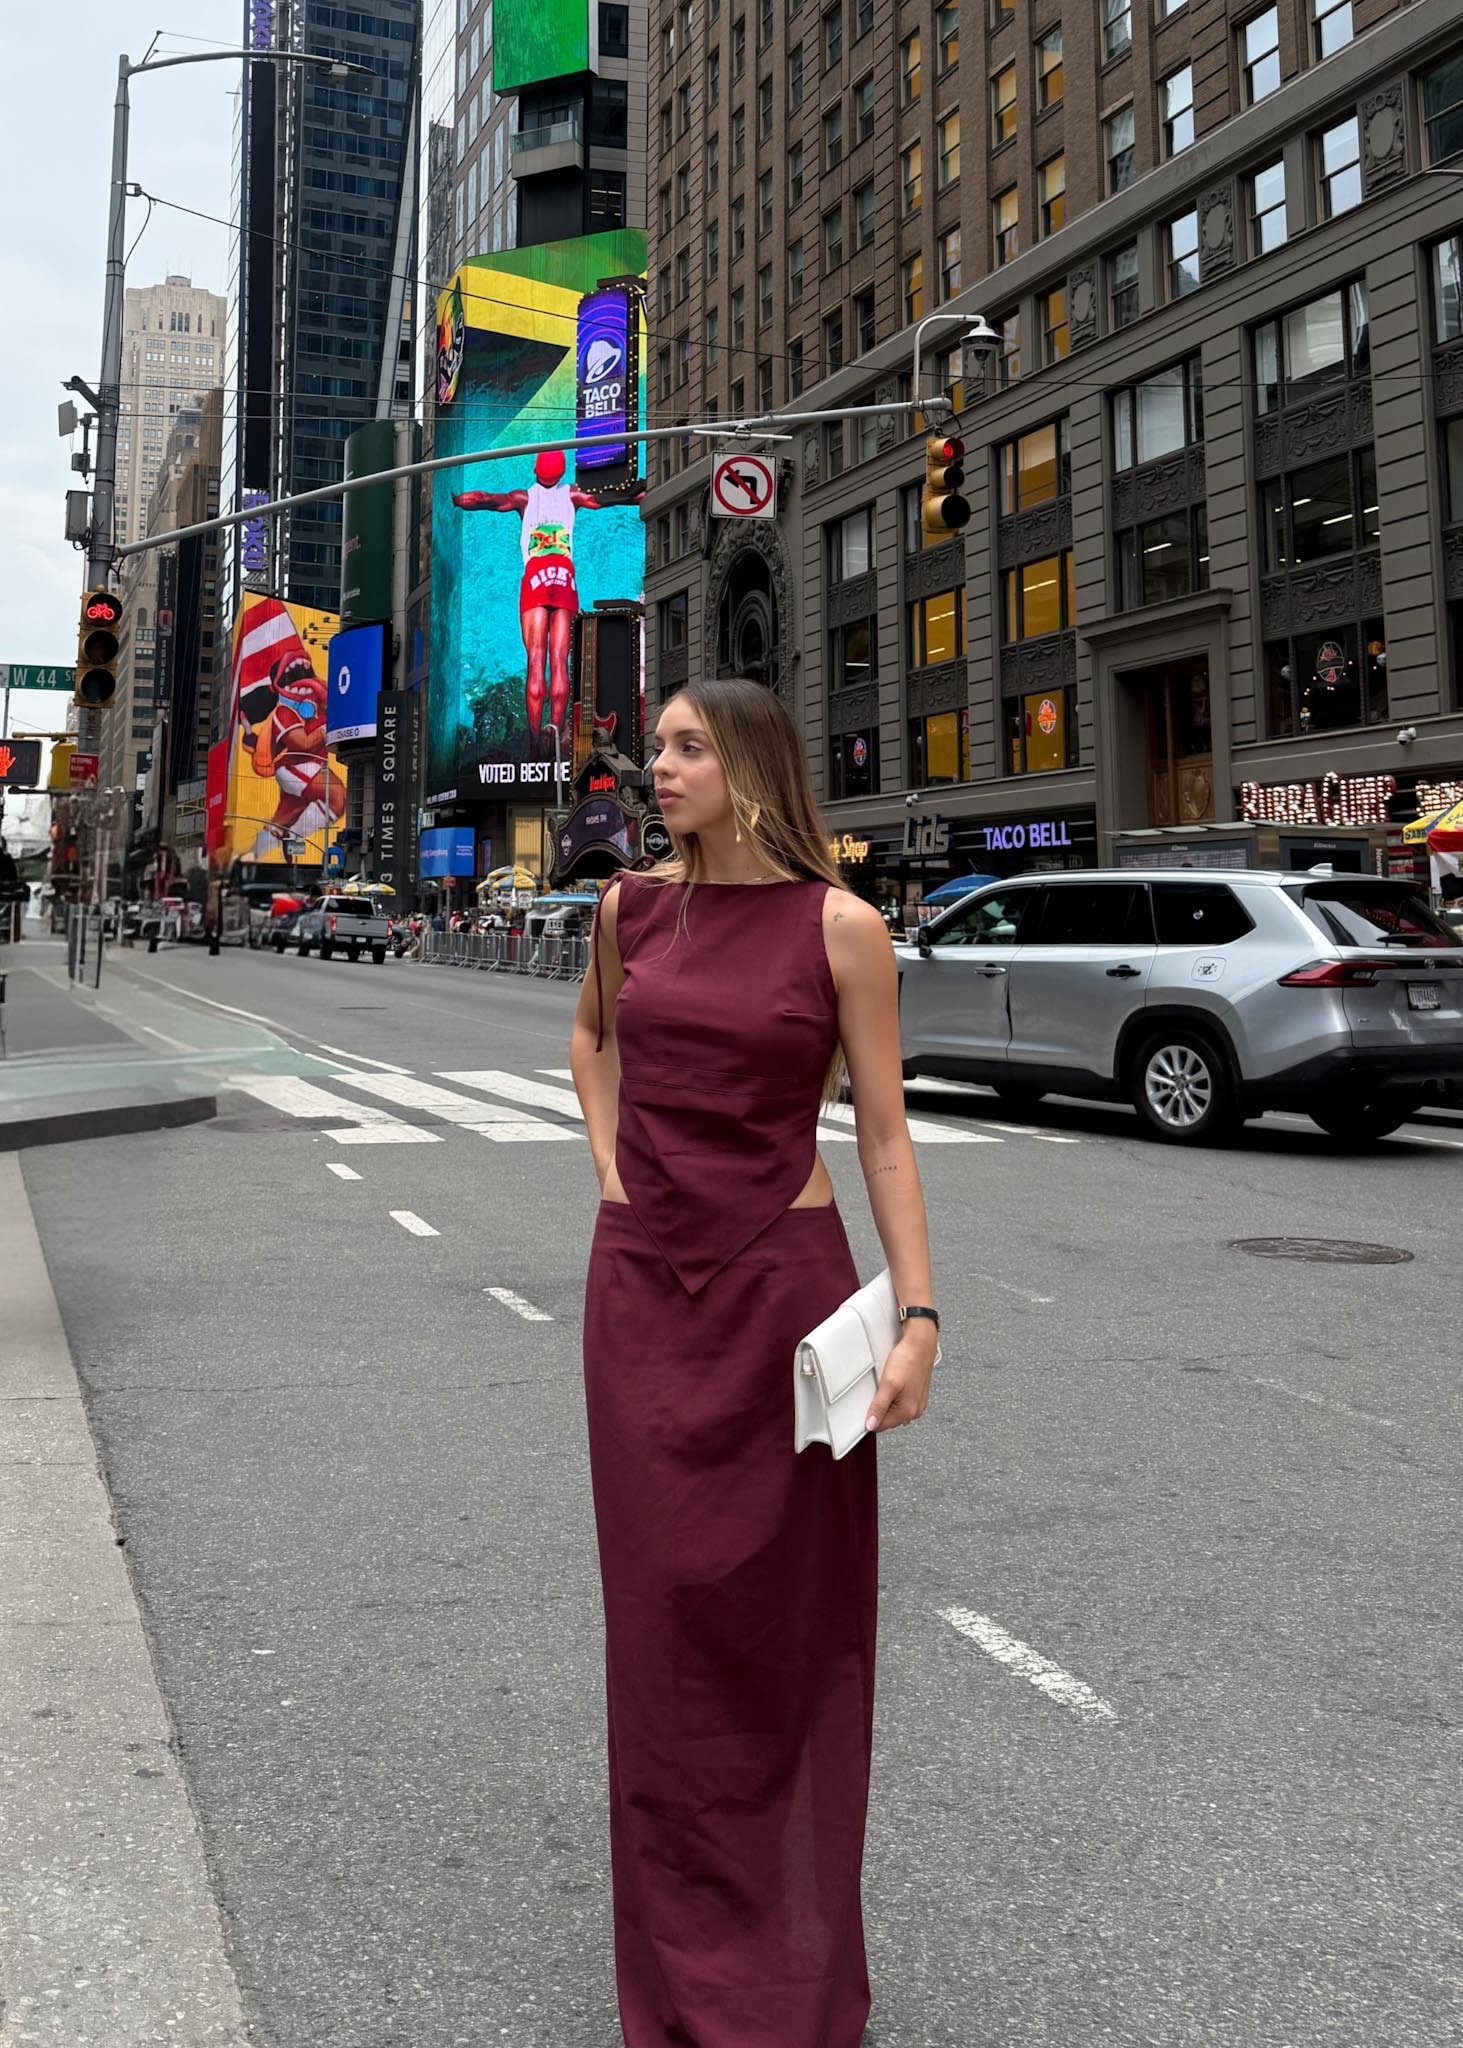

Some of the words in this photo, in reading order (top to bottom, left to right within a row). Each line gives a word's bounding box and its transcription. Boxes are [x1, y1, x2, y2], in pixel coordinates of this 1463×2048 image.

[252, 0, 271, 50] OKU
[583, 383, 621, 404] TACO
[585, 398, 621, 419] BELL
[13, 667, 28, 686] W
[36, 669, 57, 687] 44
[383, 706, 397, 782] SQUARE
[478, 763, 516, 784] VOTED
[520, 762, 551, 783] BEST
[381, 802, 394, 860] TIMES
[903, 815, 949, 856] Lids
[983, 824, 1025, 850] TACO
[1029, 821, 1072, 848] BELL
[380, 872, 393, 883] 3
